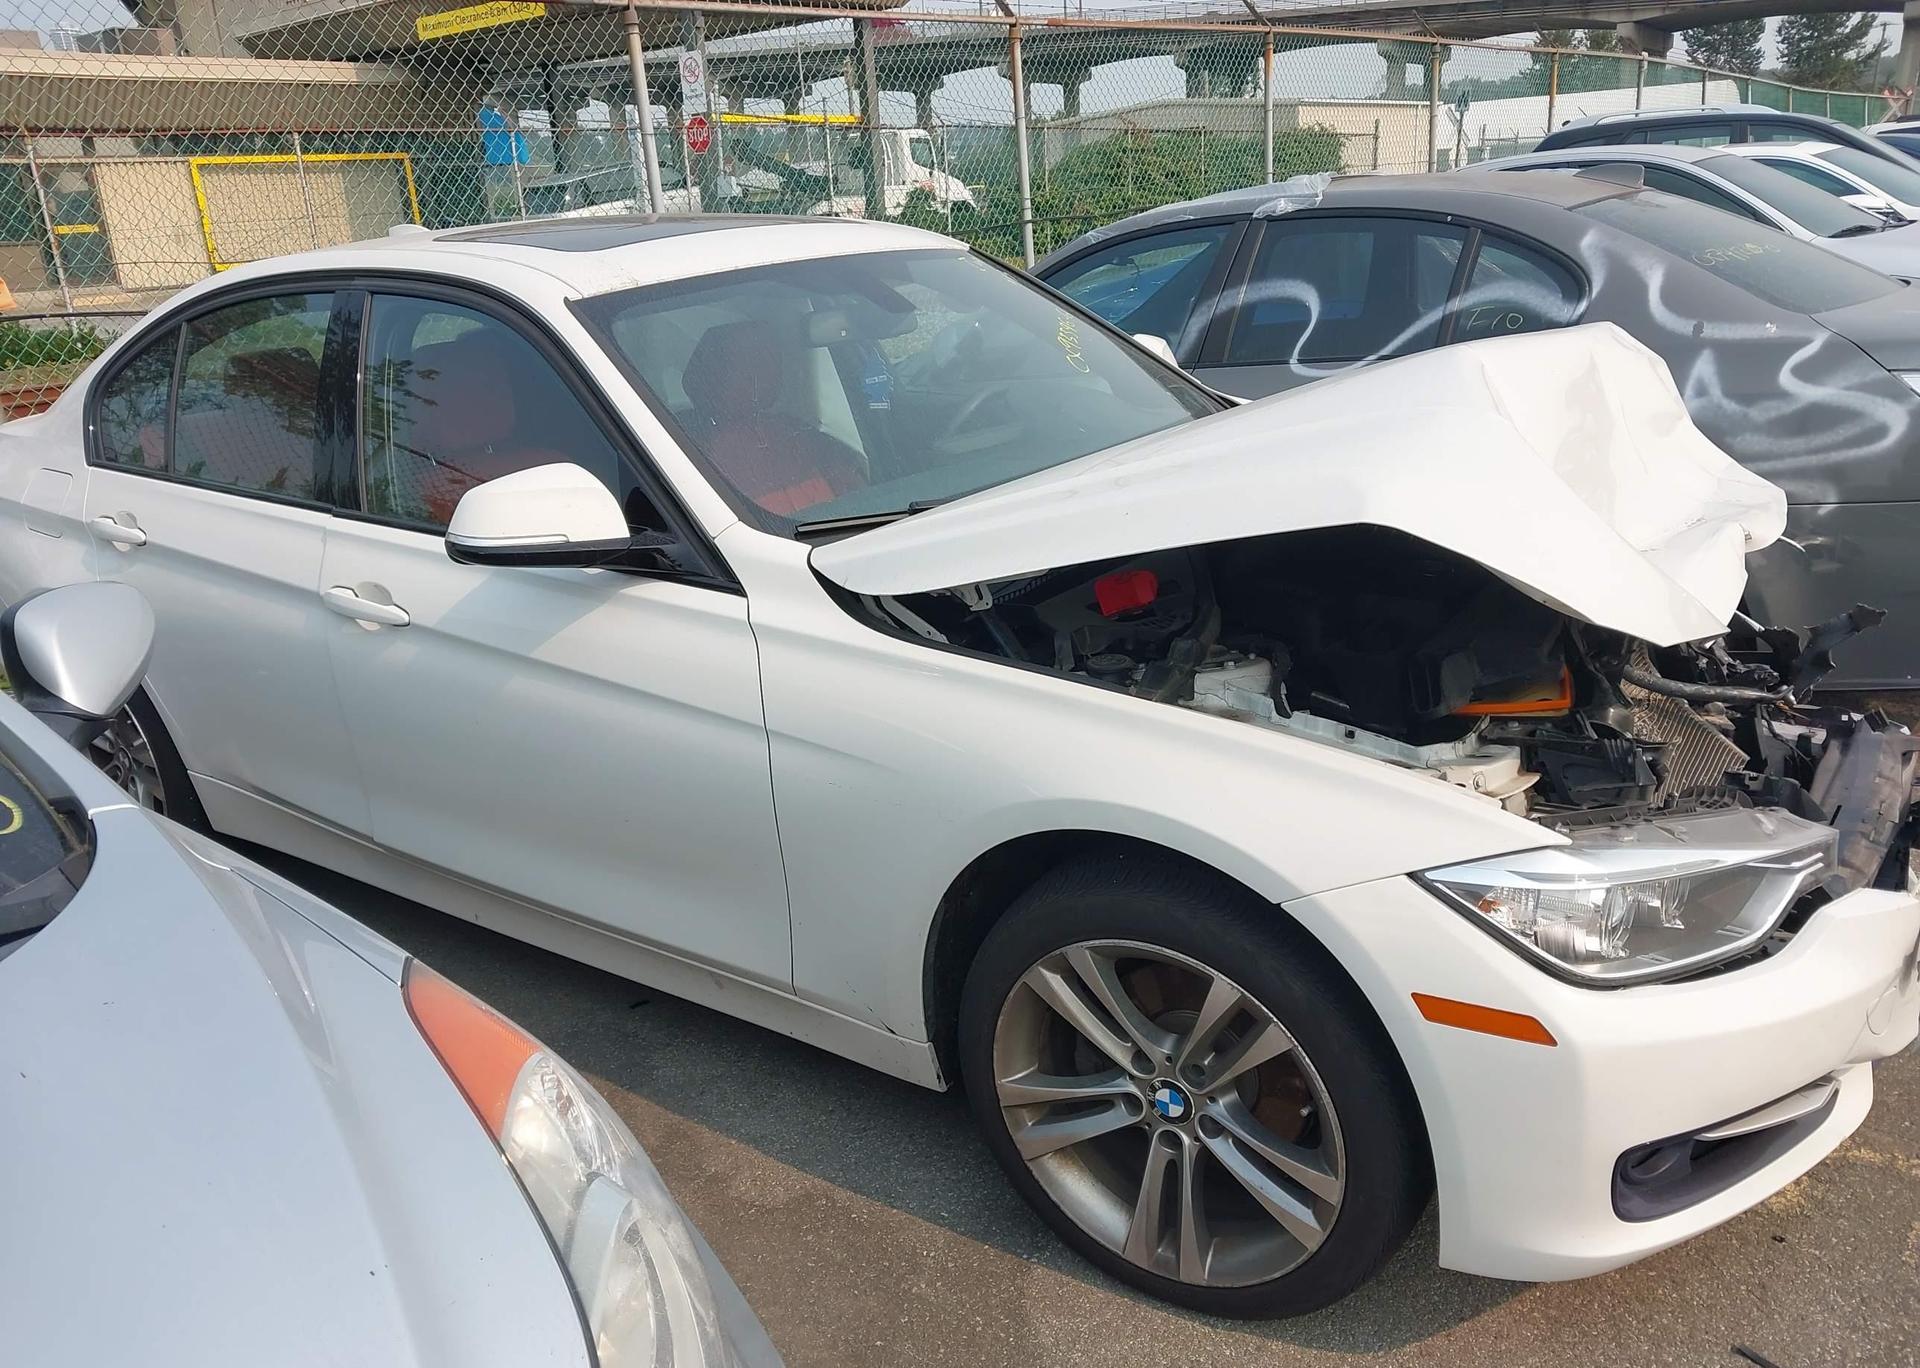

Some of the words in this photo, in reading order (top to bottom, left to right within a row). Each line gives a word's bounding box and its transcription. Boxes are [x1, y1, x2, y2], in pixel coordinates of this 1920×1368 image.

[422, 18, 454, 32] Maximum
[455, 11, 489, 25] Clearance
[689, 127, 709, 142] STOP
